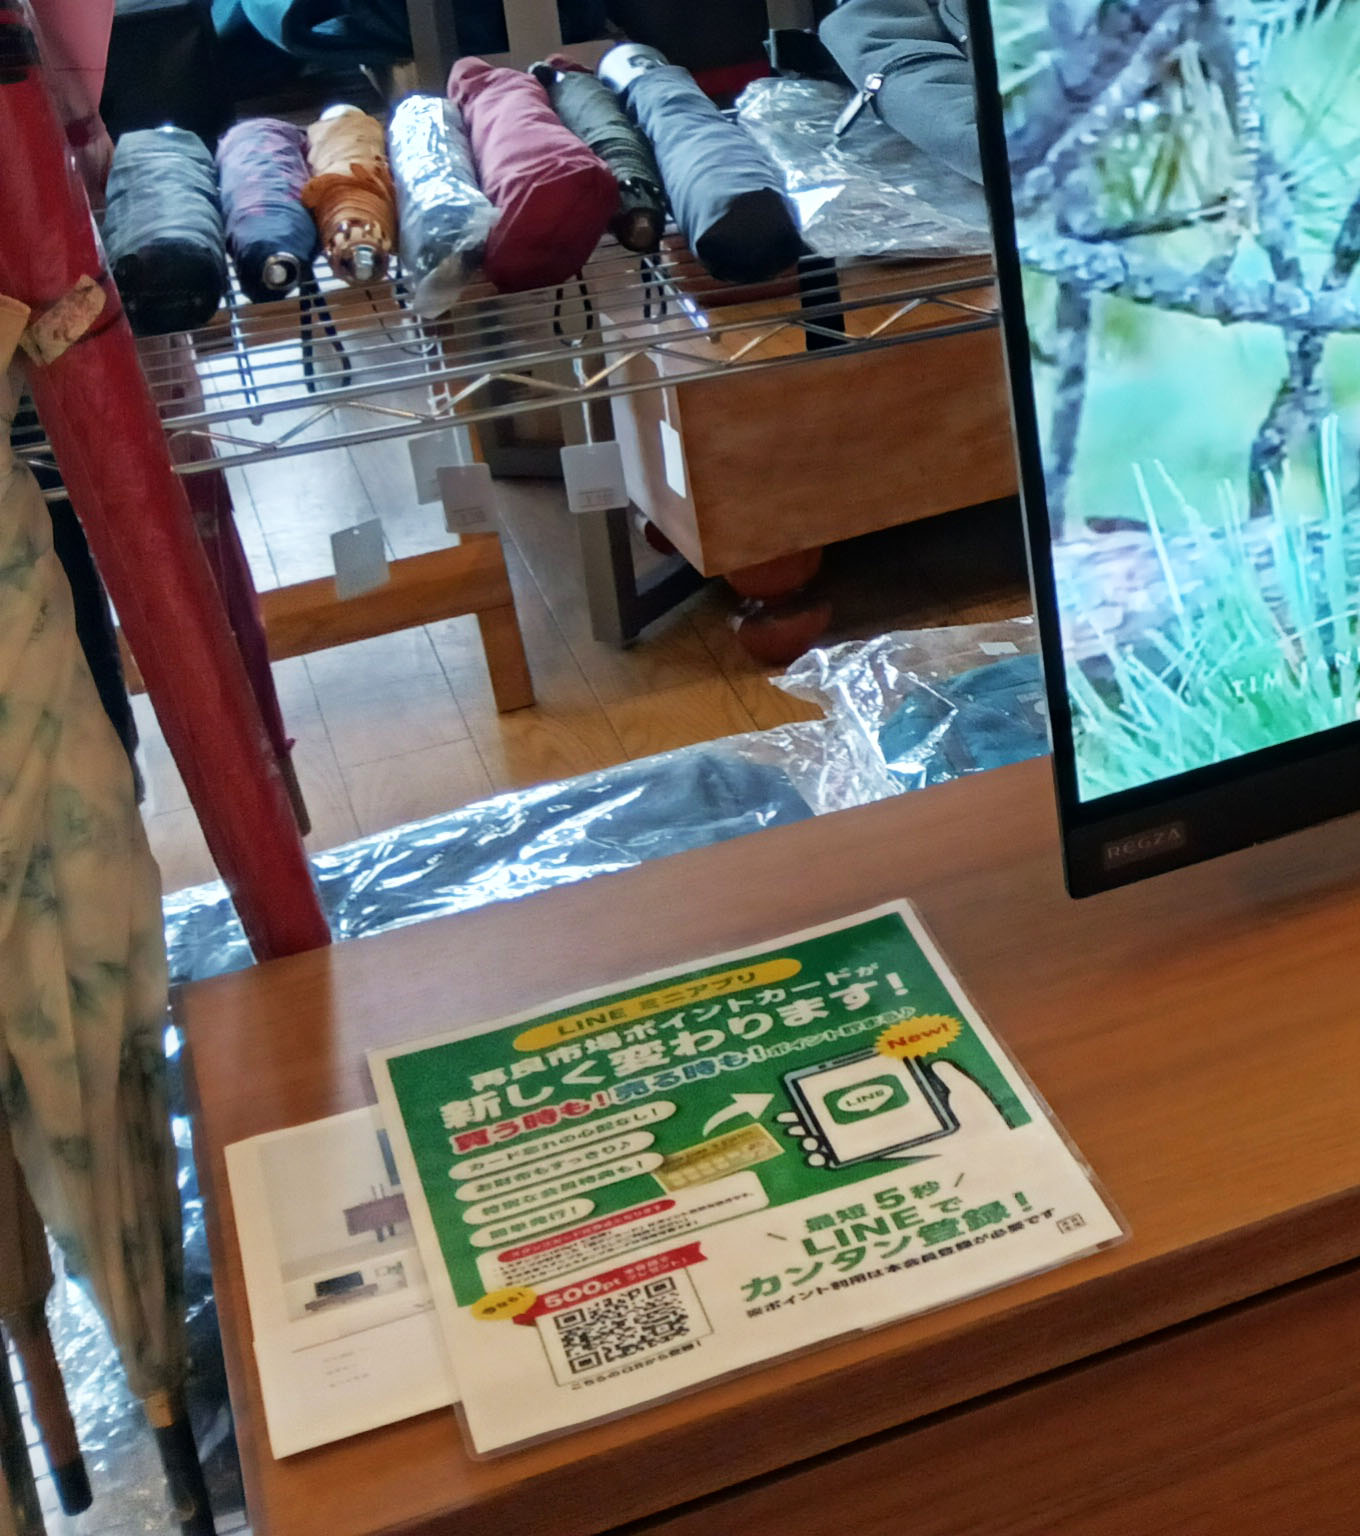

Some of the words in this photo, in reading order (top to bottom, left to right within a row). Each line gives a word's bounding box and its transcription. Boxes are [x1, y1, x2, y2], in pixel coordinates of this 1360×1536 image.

[468, 962, 880, 1094] 再良市場ポイントカードが
[557, 1009, 628, 1037] LINE
[639, 970, 756, 1012] ミニアプリ
[887, 1022, 950, 1051] New!
[439, 971, 909, 1130] 新しく変わります!
[845, 1088, 886, 1108] LINE
[740, 1191, 1034, 1302] カンタン登録!
[543, 1278, 622, 1309] 500pt
